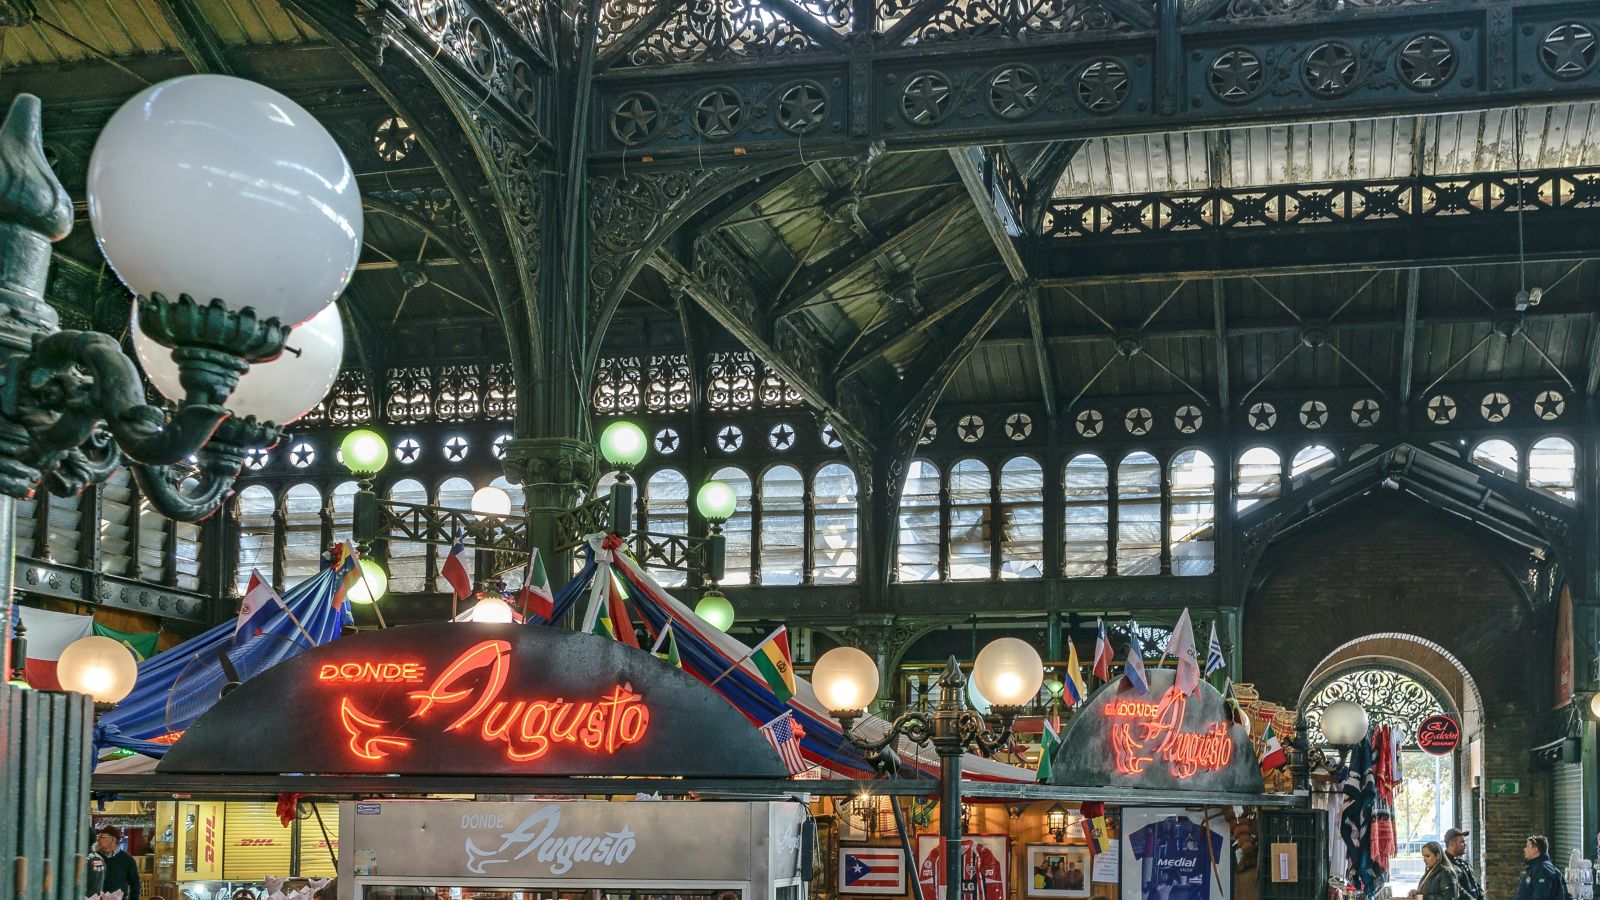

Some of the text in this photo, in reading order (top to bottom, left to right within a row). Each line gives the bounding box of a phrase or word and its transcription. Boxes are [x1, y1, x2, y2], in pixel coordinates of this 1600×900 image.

[319, 639, 650, 762] DONDE Augusto
[1104, 684, 1232, 779] DONDE Augusto
[1427, 721, 1448, 731] El
[204, 815, 216, 864] DHL
[240, 838, 275, 847] DHL
[460, 804, 637, 875] DONDE Augusto
[962, 882, 975, 891] LG
